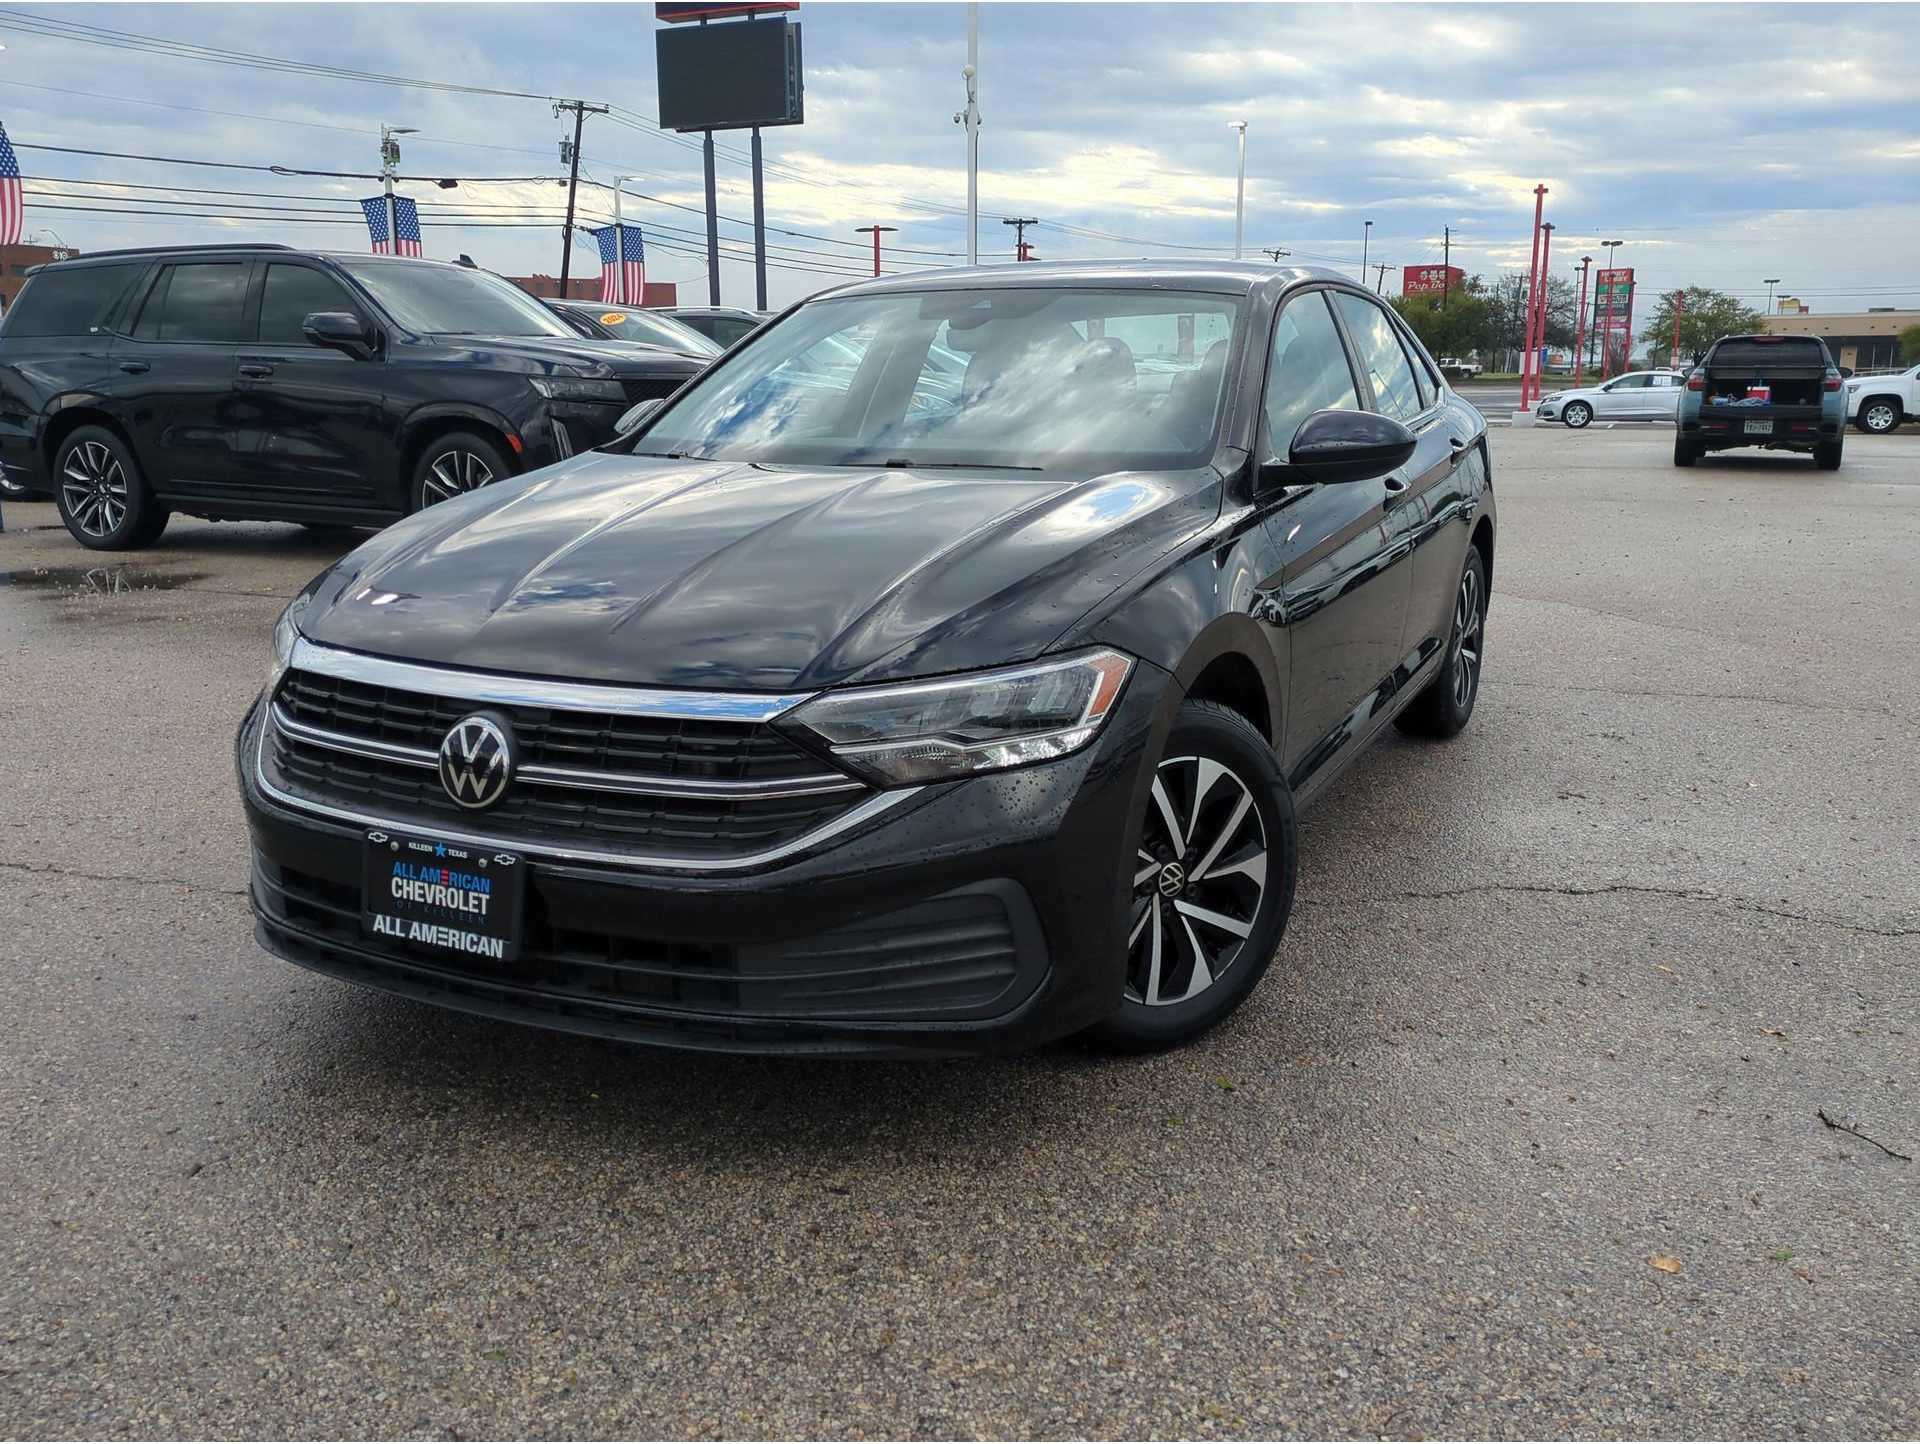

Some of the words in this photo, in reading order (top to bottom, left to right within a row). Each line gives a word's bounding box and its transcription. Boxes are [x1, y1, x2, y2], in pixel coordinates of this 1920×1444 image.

[408, 842, 433, 853] KILLEEN
[448, 848, 469, 859] TEXAS
[391, 876, 491, 915] CHEVROLET
[392, 861, 417, 879] ALL
[419, 865, 491, 894] AMERICAN
[373, 913, 406, 938] ALL
[409, 922, 504, 959] AMERICAN
